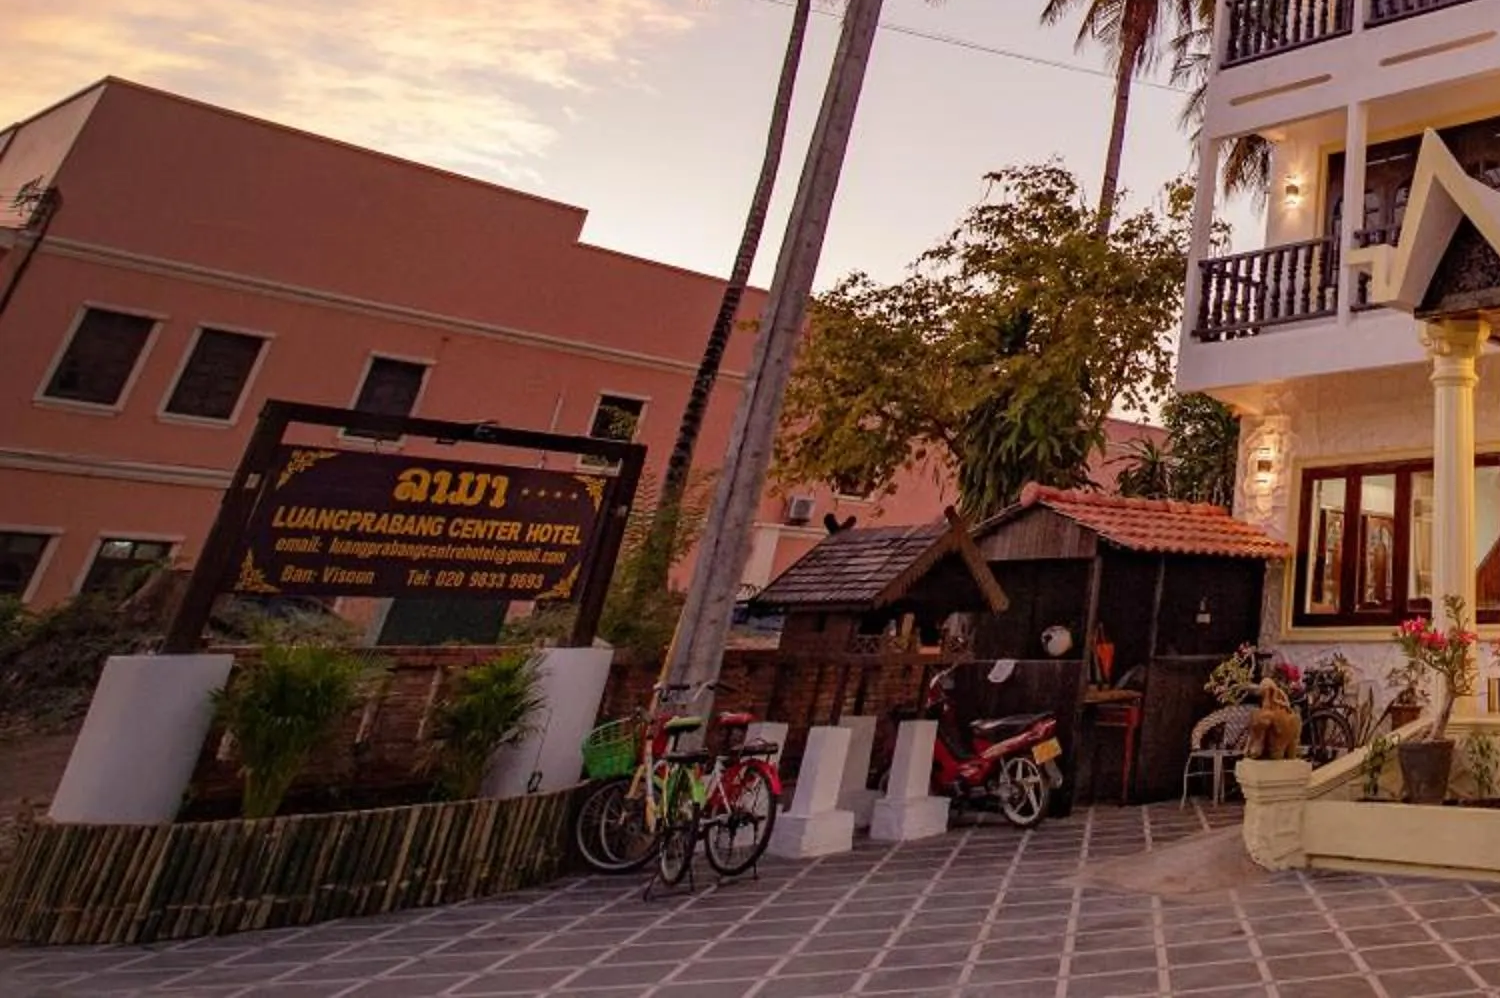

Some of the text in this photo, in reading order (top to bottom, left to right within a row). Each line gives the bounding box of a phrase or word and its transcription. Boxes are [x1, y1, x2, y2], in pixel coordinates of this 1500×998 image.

[271, 505, 582, 544] LUANGPRABANG CENTER HOTEL
[275, 535, 322, 553] email:
[406, 569, 431, 587] Tel:
[435, 569, 464, 588] 020
